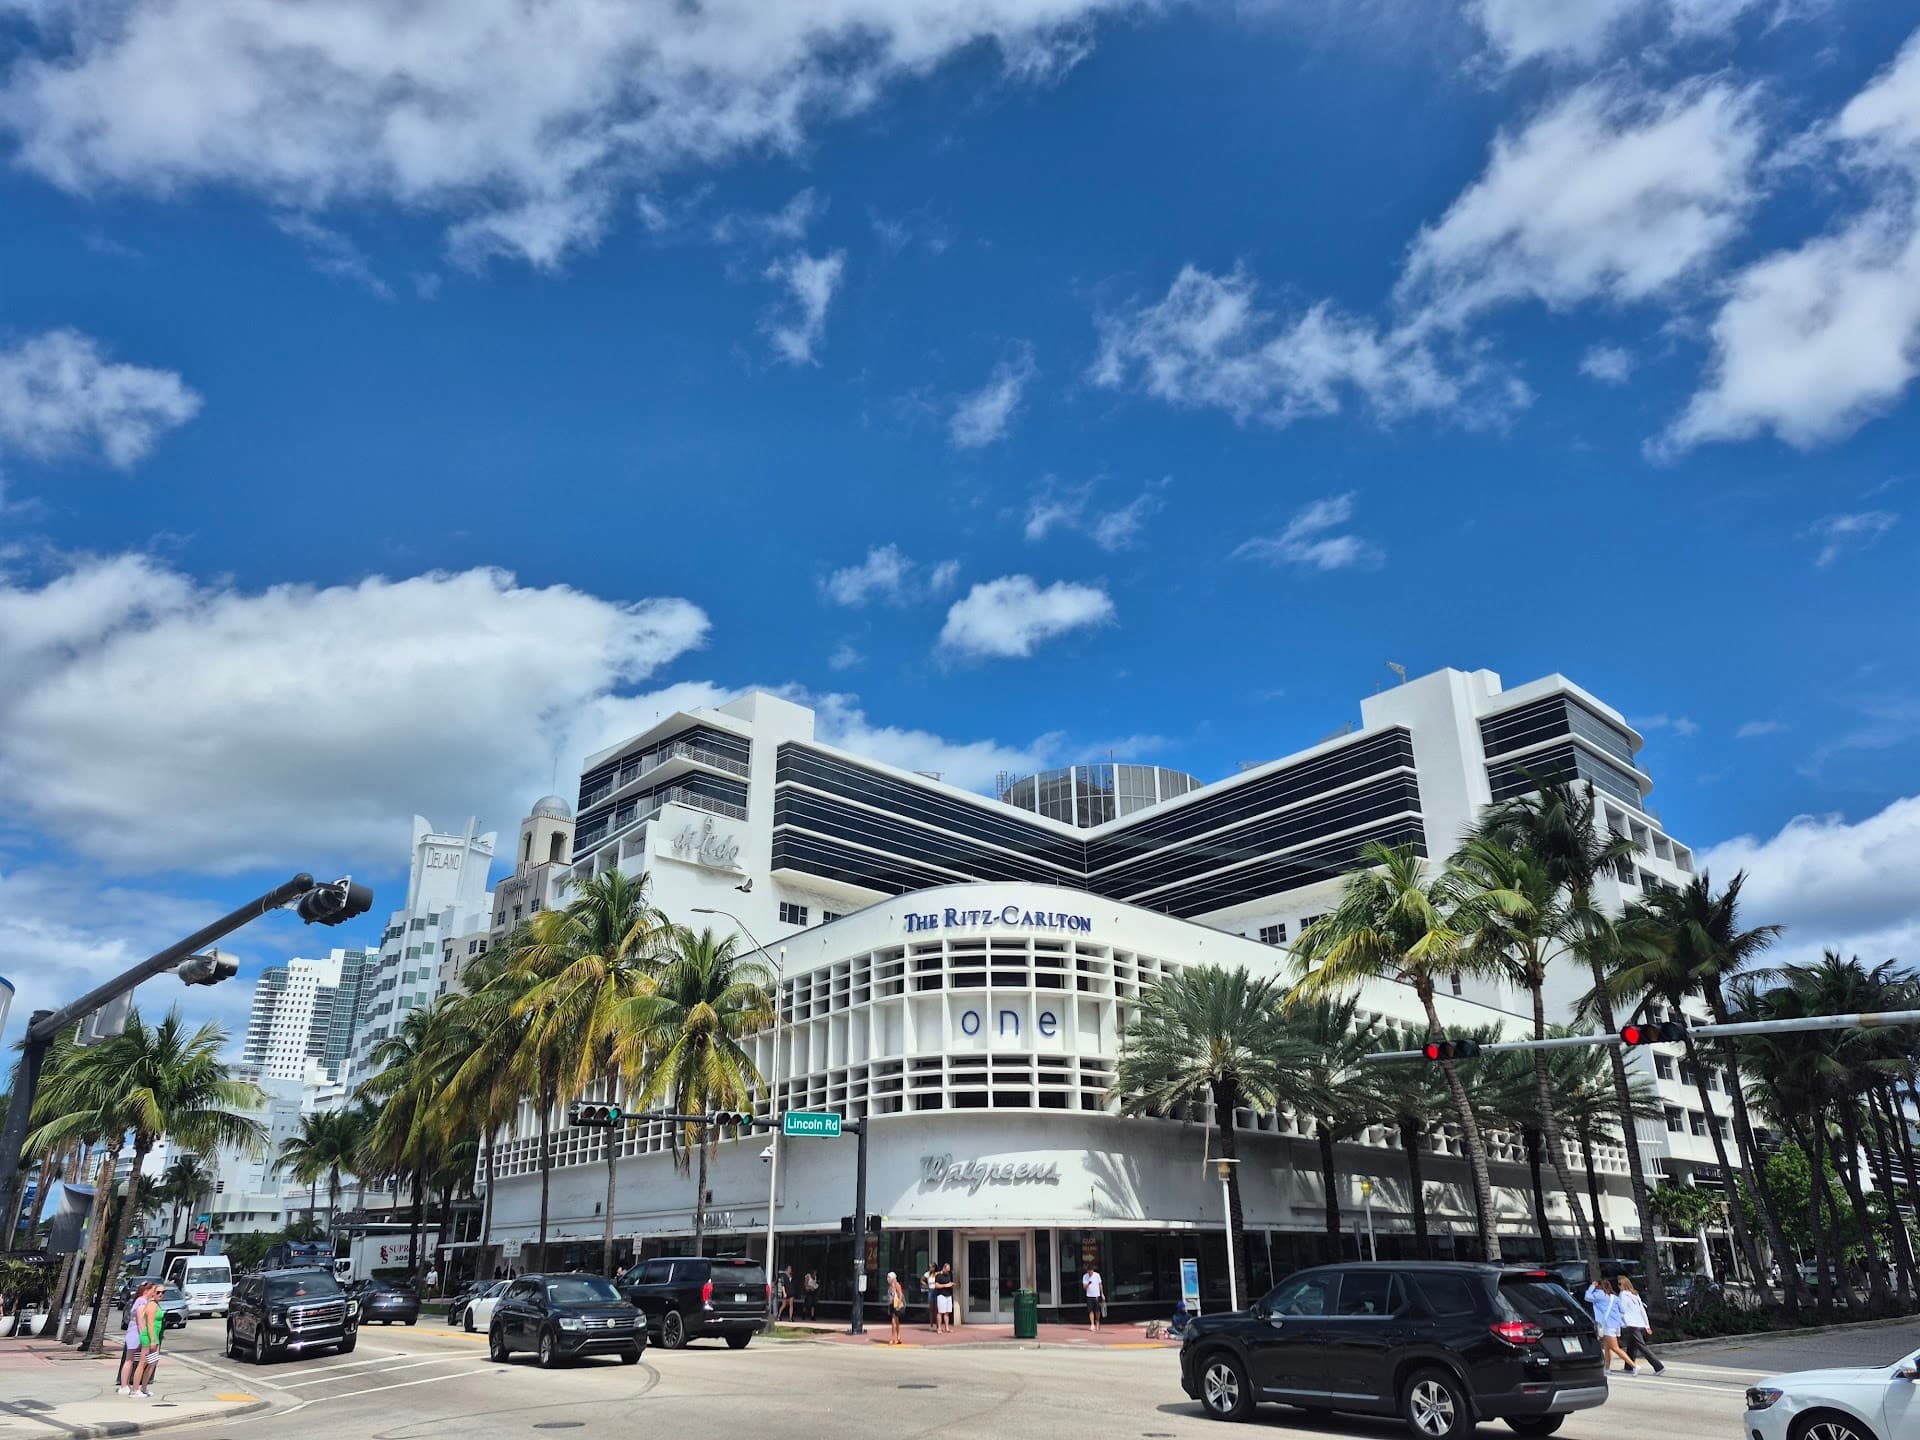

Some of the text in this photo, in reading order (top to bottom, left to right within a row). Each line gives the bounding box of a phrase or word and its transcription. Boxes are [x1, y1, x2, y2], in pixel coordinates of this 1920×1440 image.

[426, 846, 460, 870] DELANO
[904, 905, 1091, 933] THE RITZ-CARLTON
[961, 1010, 1057, 1037] one
[787, 1117, 838, 1131] Lincoln Rd
[919, 1152, 1062, 1194] Walgreens
